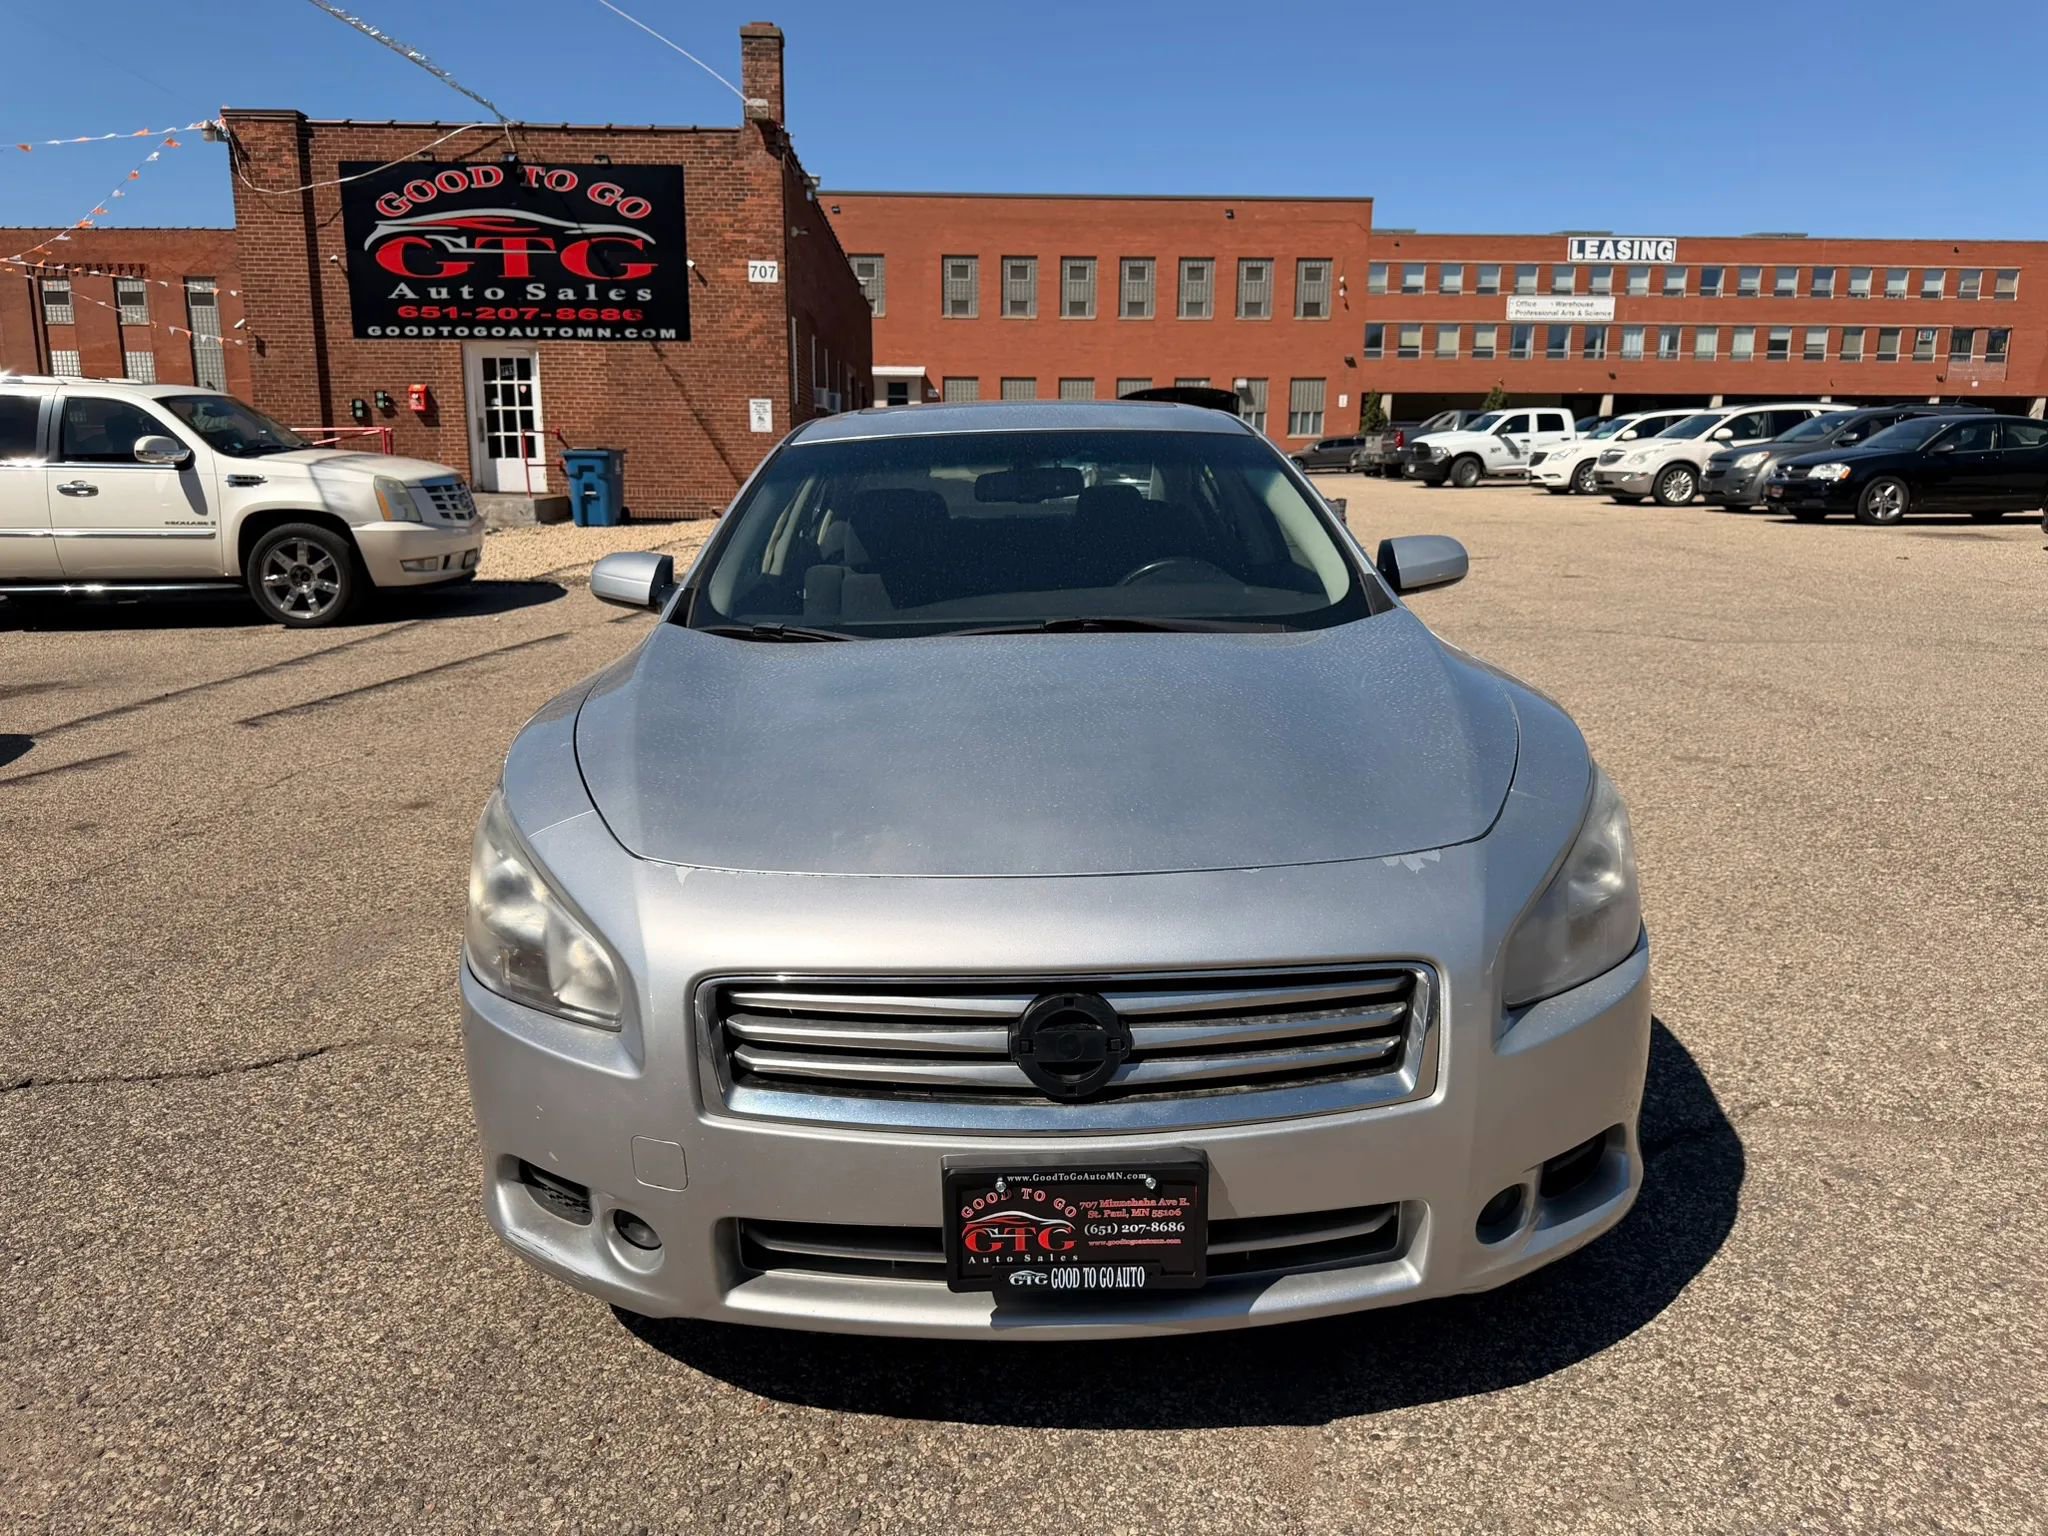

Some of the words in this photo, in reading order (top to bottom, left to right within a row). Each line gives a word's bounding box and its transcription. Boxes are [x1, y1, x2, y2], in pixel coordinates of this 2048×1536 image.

[375, 165, 504, 217] GOOD
[520, 165, 579, 192] TO
[587, 181, 652, 219] GO
[375, 235, 659, 280] GTG
[1571, 240, 1673, 260] LEASING
[750, 265, 776, 279] 707
[388, 282, 505, 301] Auto
[525, 282, 653, 301] Sales
[397, 305, 644, 322] 651-207-8686
[367, 325, 677, 340] GOODTOGOAUTOMN.COM
[1006, 1172, 1147, 1182] www.GoodToGoAutoMN.com
[1021, 1188, 1046, 1202] TO
[1053, 1198, 1077, 1218] GO
[1080, 1201, 1098, 1210] 707
[1158, 1198, 1178, 1206] Ave
[1179, 1198, 1190, 1206] E.
[1088, 1210, 1101, 1219] St.
[1103, 1209, 1129, 1218] Paul,
[1131, 1208, 1150, 1217] MN
[1151, 1208, 1182, 1218] 55106
[1084, 1222, 1118, 1236] (651)
[1121, 1222, 1186, 1234] 207-8686
[964, 1226, 1077, 1253] GTG
[968, 1256, 1013, 1264] Auto
[1024, 1254, 1078, 1262] Sales
[1051, 1267, 1080, 1289] GOOD
[1083, 1267, 1097, 1288] TO
[1100, 1267, 1114, 1288] GO
[1115, 1266, 1145, 1288] AUTO
